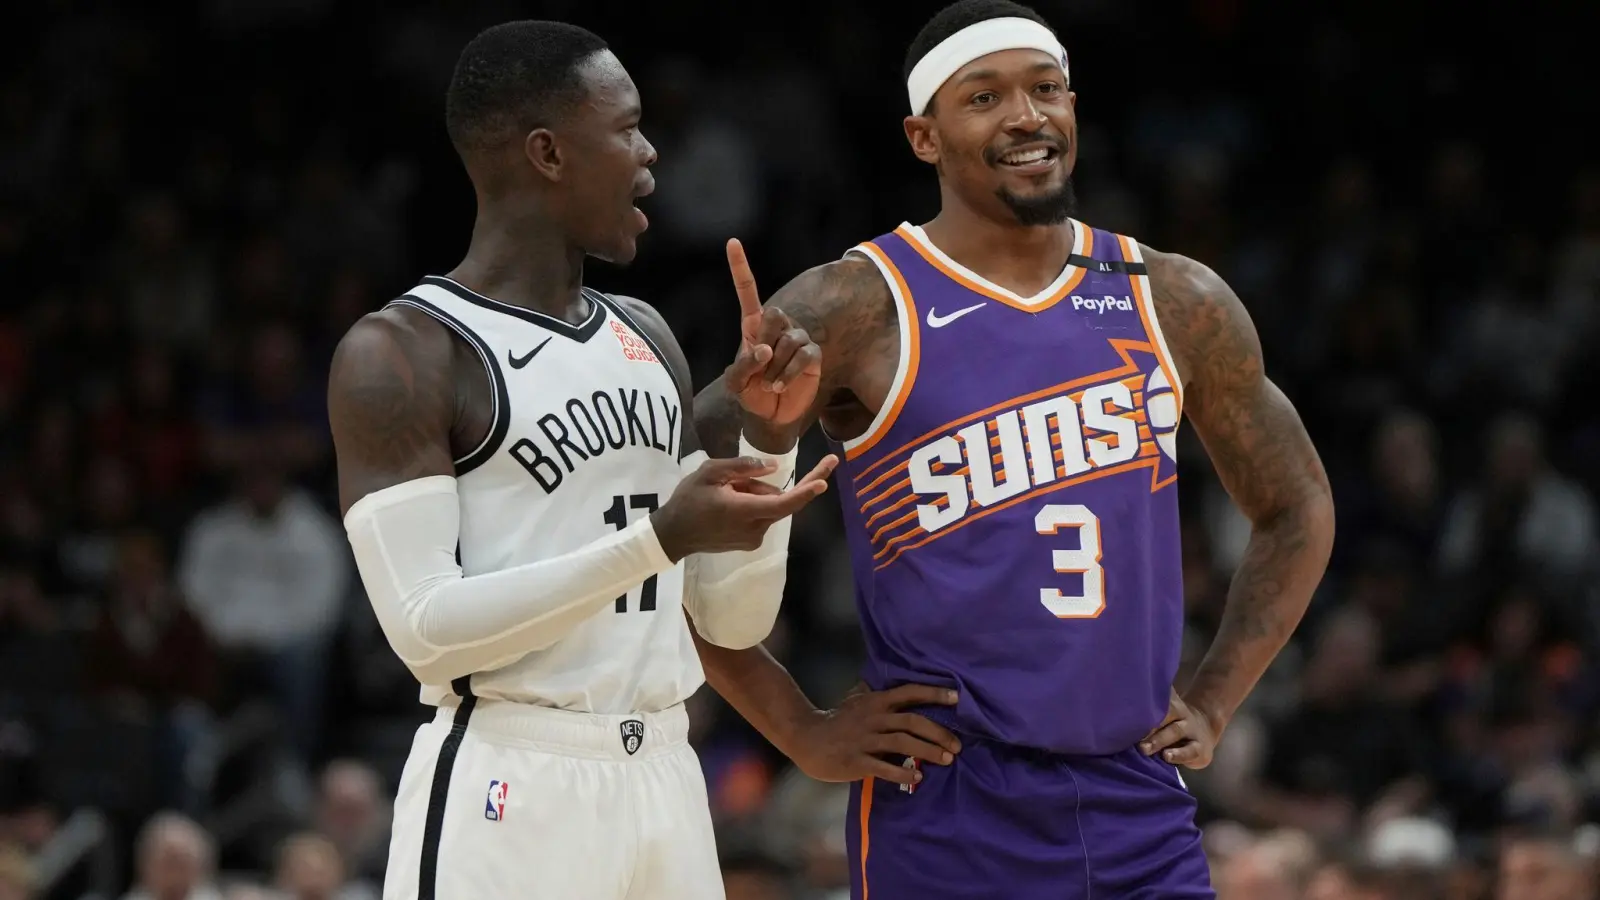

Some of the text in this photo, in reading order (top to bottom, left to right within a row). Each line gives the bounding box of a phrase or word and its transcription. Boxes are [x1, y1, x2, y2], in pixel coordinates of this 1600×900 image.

[1099, 262, 1113, 272] AL
[1070, 295, 1133, 315] PayPal
[623, 347, 660, 364] GUIDE
[508, 388, 682, 495] BROOKLY
[907, 381, 1140, 533] SUNS
[1034, 504, 1106, 619] 3
[621, 721, 643, 737] NETS
